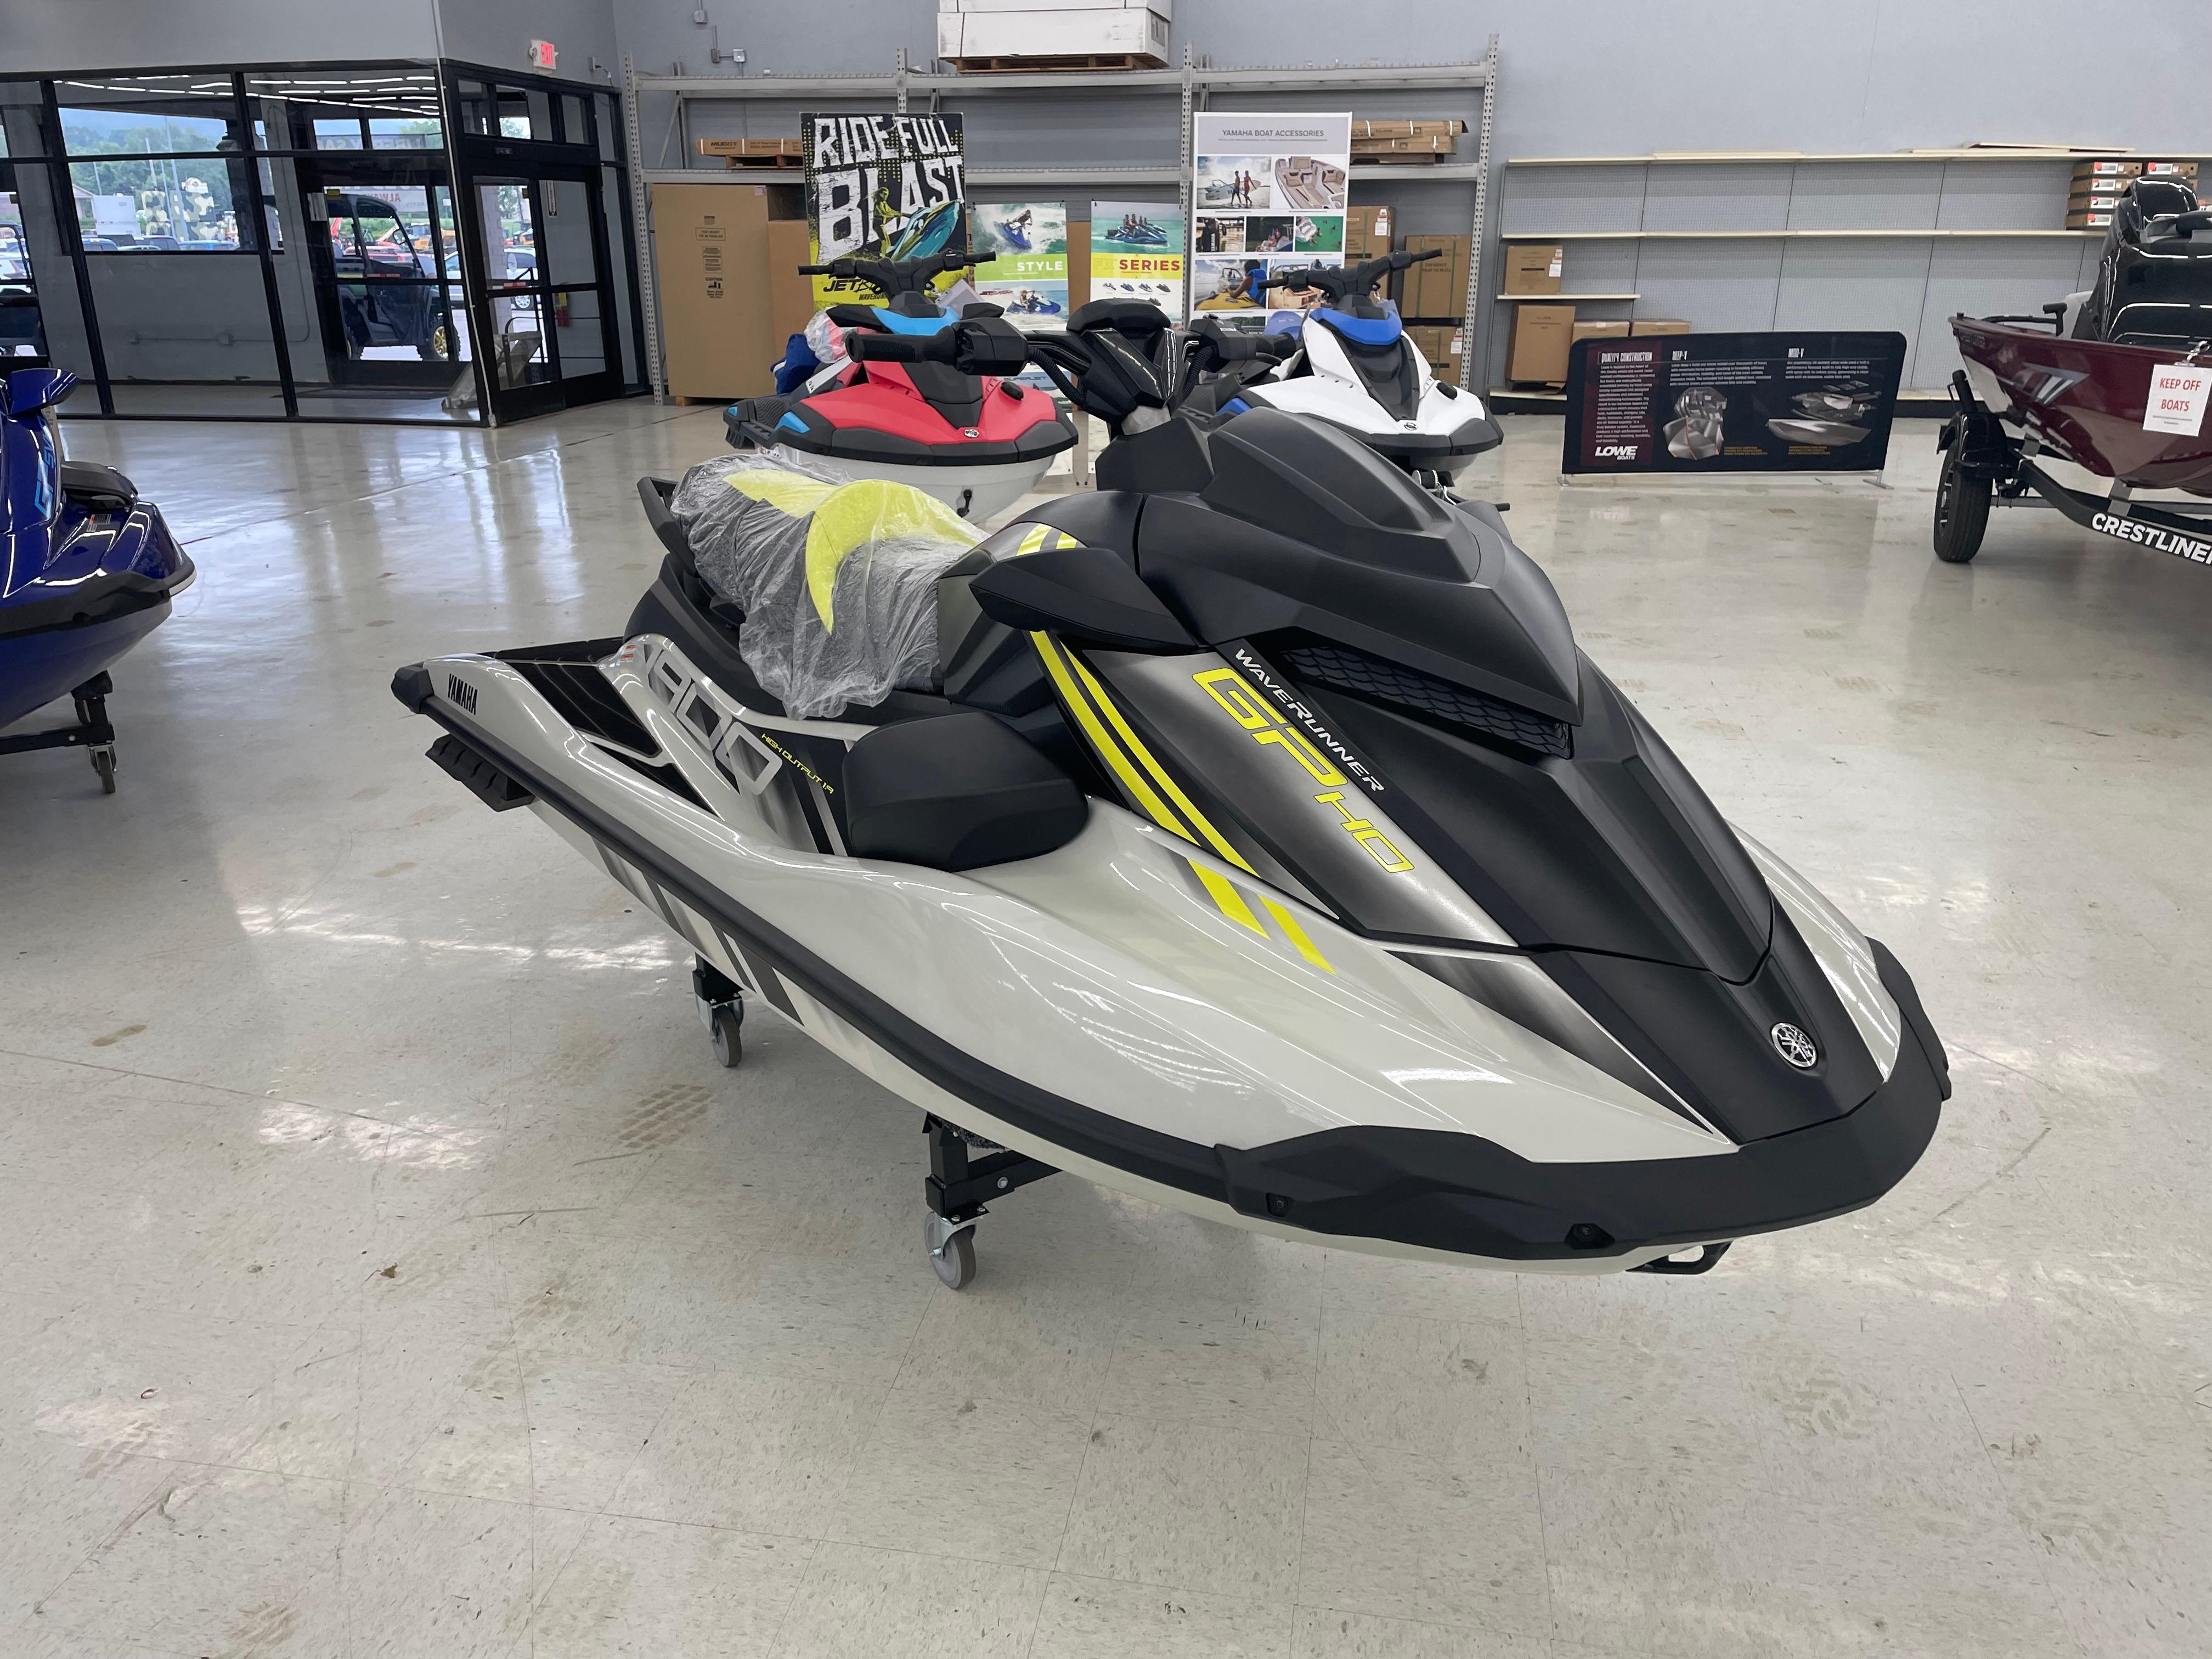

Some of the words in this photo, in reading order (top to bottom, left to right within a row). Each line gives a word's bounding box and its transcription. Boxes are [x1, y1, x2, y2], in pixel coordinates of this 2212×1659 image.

[813, 116, 899, 168] RIDE
[894, 116, 958, 156] FULL
[815, 155, 965, 266] BLAST
[1017, 261, 1063, 272] STYLE
[1119, 259, 1180, 271] SERIES
[1601, 352, 1620, 363] QUALITY
[1620, 351, 1653, 363] CONSTRUCTION
[2159, 377, 2181, 389] KEEP
[2182, 379, 2202, 391] OFF
[2160, 398, 2190, 411] BOATS
[1595, 445, 1638, 456] LOWE
[447, 673, 478, 716] YAMAHA
[1234, 647, 1386, 792] WAVERUNNER
[760, 732, 783, 753] HIGH
[782, 749, 823, 783] OUTPUT
[1191, 667, 1348, 787] GP
[1313, 791, 1415, 874] HO
